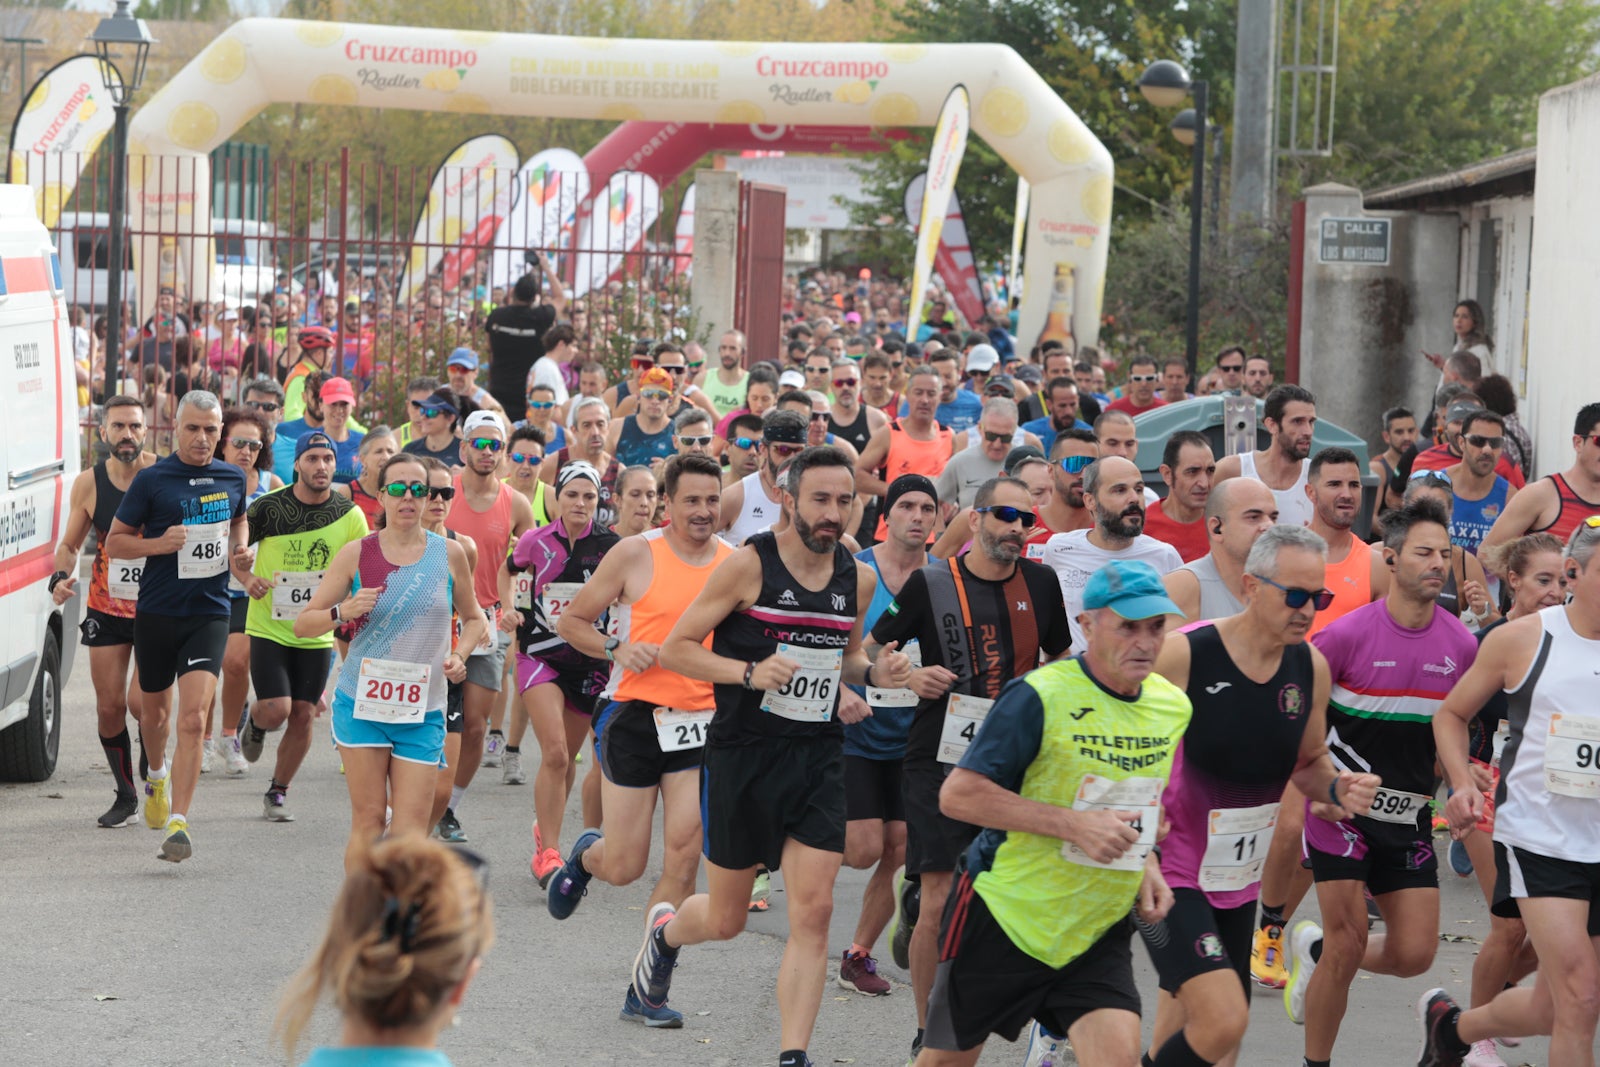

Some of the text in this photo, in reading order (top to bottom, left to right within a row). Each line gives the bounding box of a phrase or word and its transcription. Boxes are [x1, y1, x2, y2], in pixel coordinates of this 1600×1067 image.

[345, 39, 477, 68] Cruzcampo
[510, 56, 537, 73] CON
[586, 60, 648, 77] NATURAL
[756, 55, 889, 80] Cruzcampo
[357, 67, 421, 91] Radler
[510, 75, 719, 99] DOBLEMENTE REFRESCANTE
[768, 82, 832, 106] Radler
[32, 82, 91, 156] Cruzcampo
[1344, 223, 1383, 235] CALLE
[714, 395, 738, 406] FILA
[182, 510, 231, 525] MARCELINO
[202, 500, 230, 513] PADRE
[192, 541, 222, 560] 486
[288, 540, 302, 551] XI
[291, 588, 312, 603] 64
[368, 628, 381, 644] LA
[380, 572, 426, 630] SPORTIVA
[366, 679, 421, 703] 2018
[1073, 735, 1170, 750] ATLETISMO
[1234, 836, 1259, 861] 11
